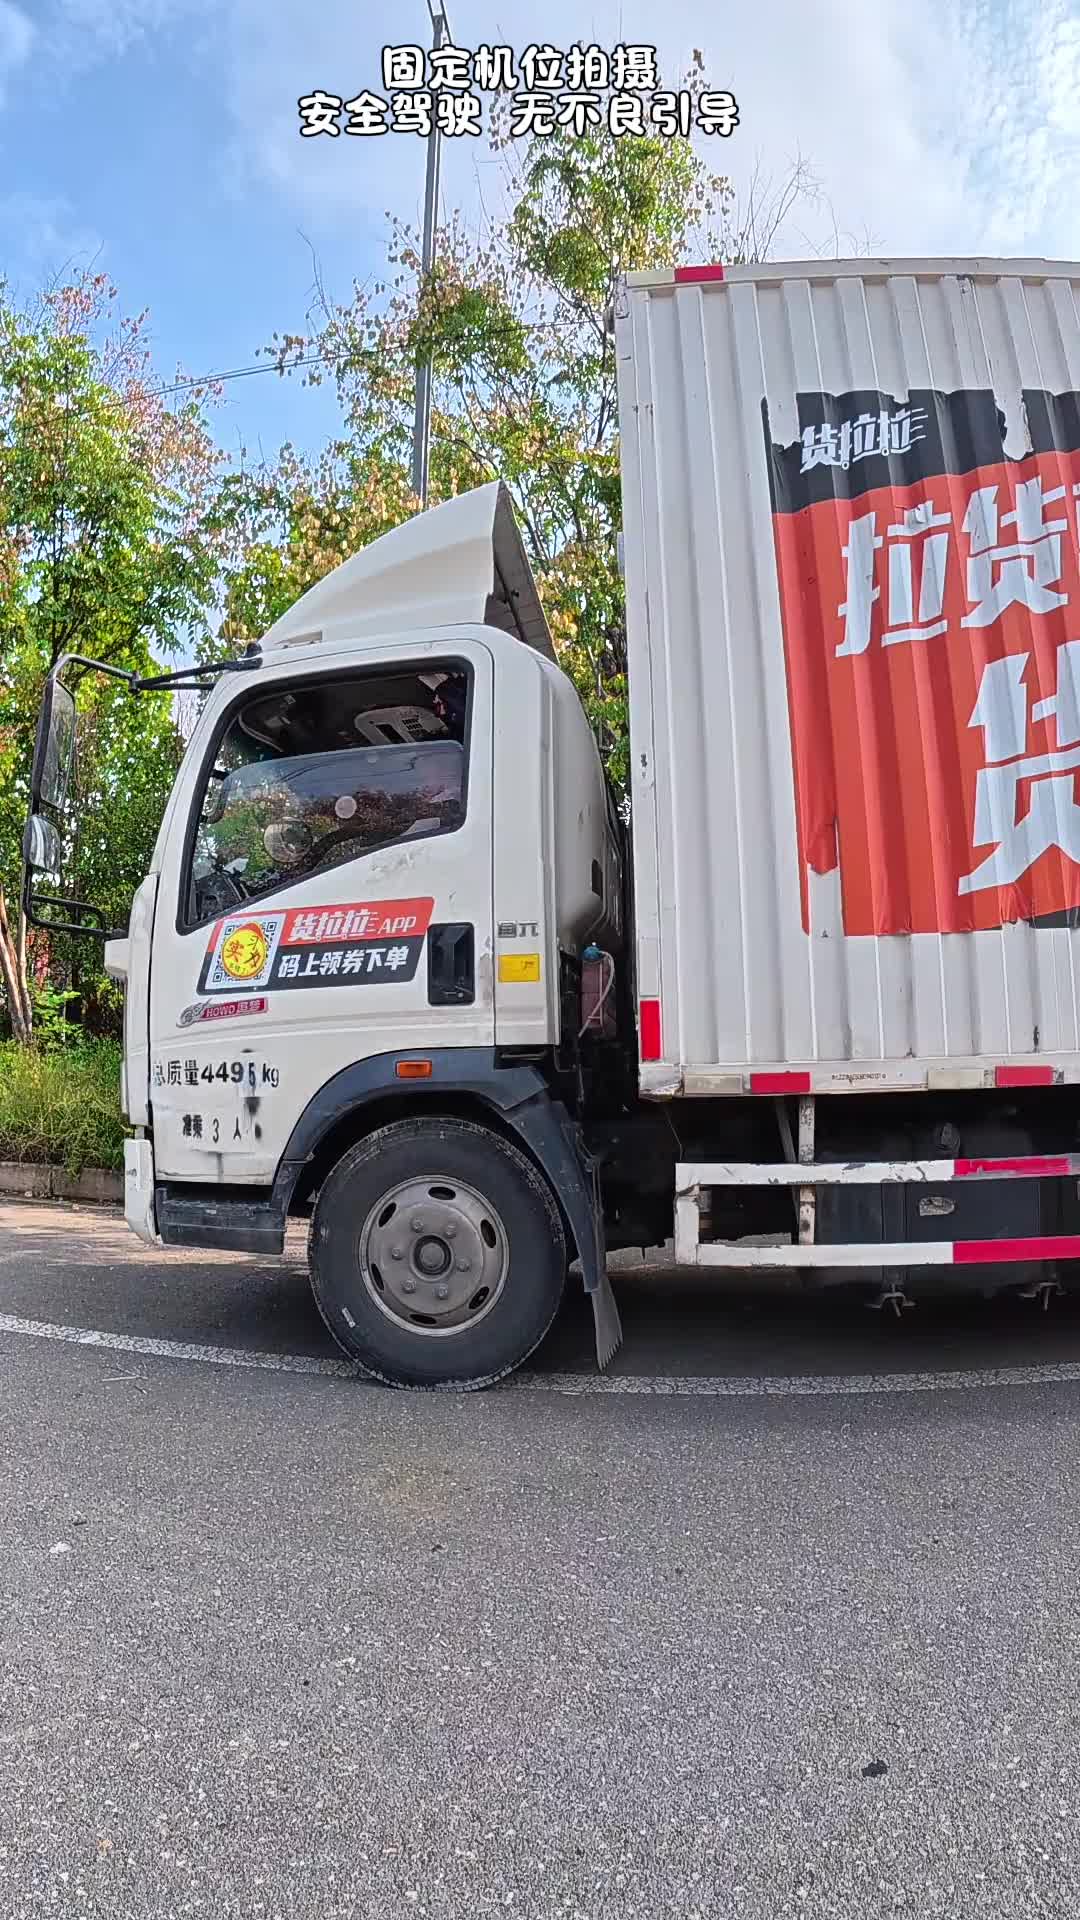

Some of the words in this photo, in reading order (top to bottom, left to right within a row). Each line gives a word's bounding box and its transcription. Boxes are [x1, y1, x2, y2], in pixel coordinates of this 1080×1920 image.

[800, 407, 922, 474] 货拉拉
[835, 474, 1080, 657] 拉货
[288, 908, 374, 942] 货拉拉
[377, 916, 416, 934] APP
[277, 945, 409, 978] 码上领券下单
[206, 1003, 235, 1017] HOWO
[212, 1117, 220, 1144] 3
[233, 1116, 241, 1140] 人
